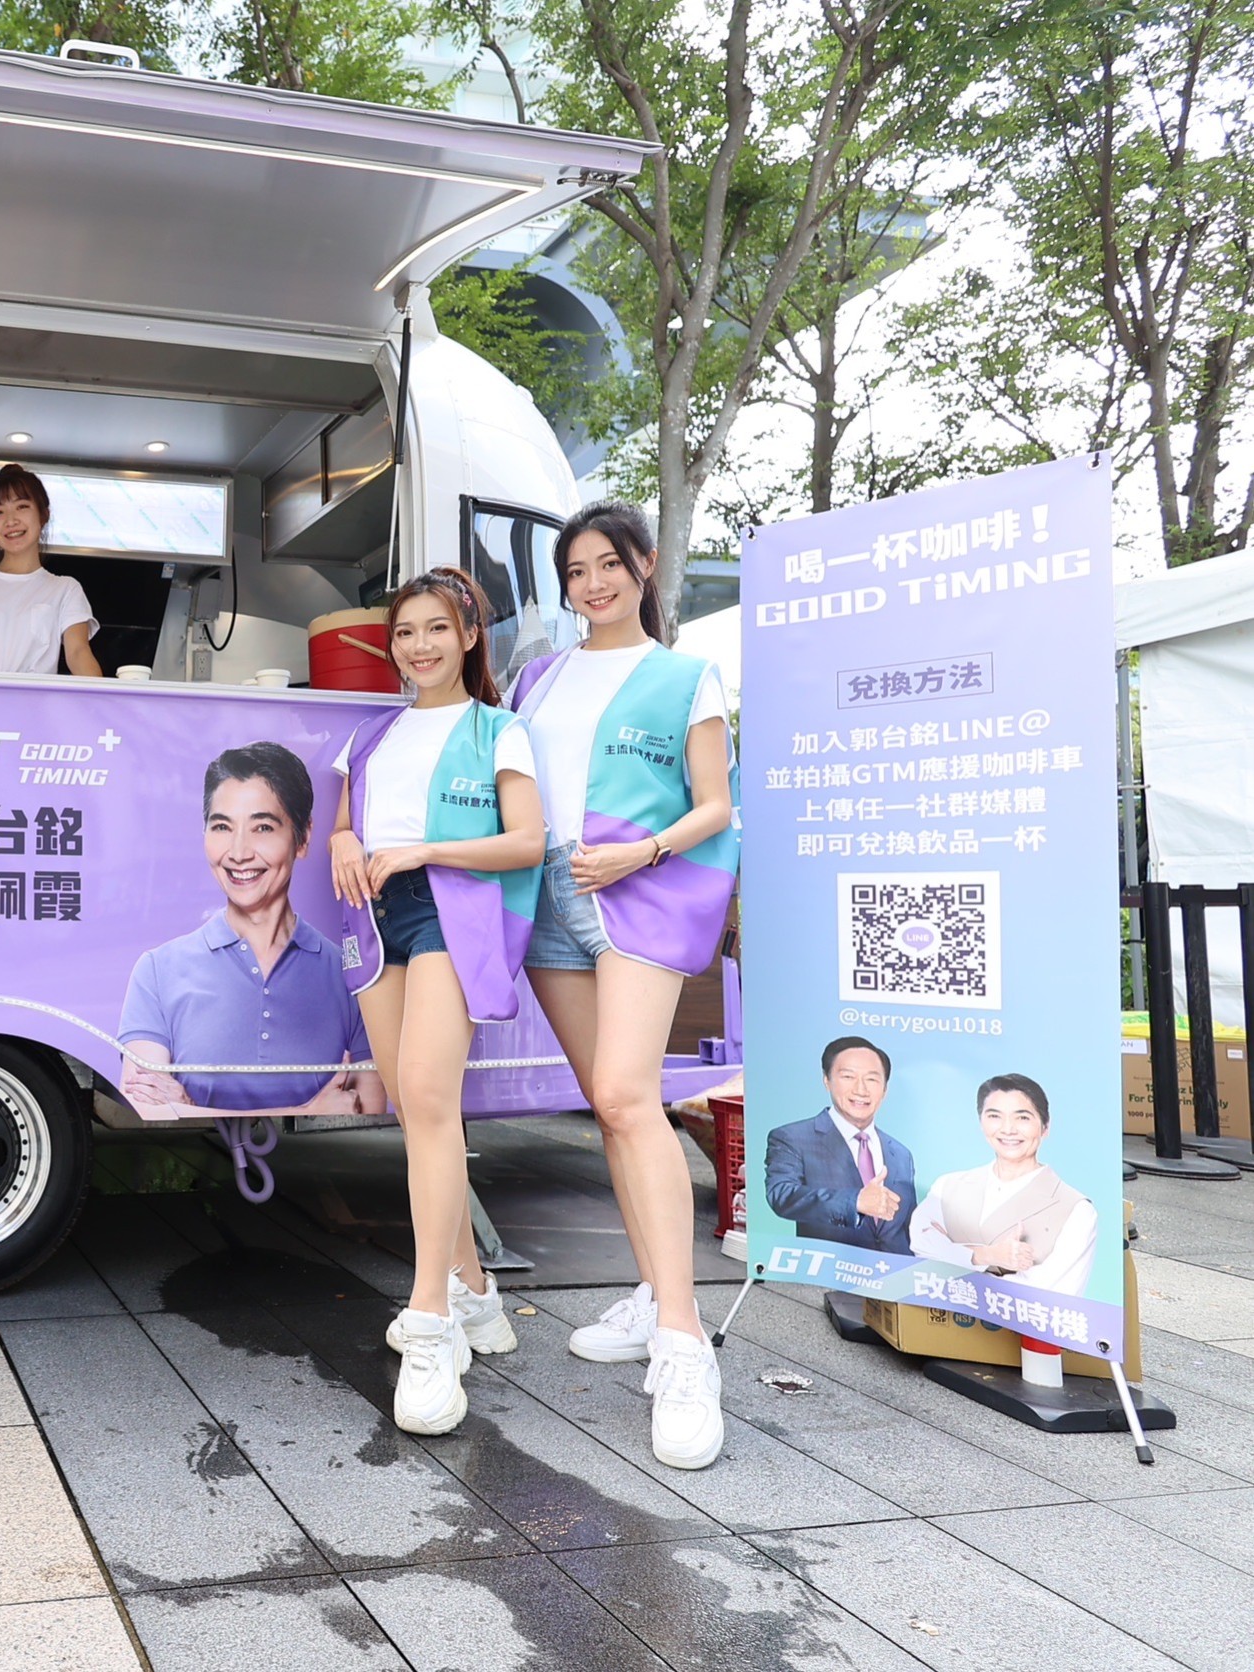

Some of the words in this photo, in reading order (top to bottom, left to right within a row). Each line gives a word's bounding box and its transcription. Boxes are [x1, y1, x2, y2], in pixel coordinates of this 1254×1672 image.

[756, 586, 887, 628] GOOD
[847, 661, 983, 702] 兌換方法
[618, 726, 649, 744] GT
[791, 709, 1051, 755] 加入郭台銘LINE@
[19, 743, 93, 762] GOOD
[765, 745, 1084, 790] 並拍攝GTM應援咖啡車
[450, 777, 483, 792] GT
[796, 786, 1047, 823] 上傳任一社群媒體
[797, 825, 1047, 857] 即可兌換飲品一杯
[906, 933, 930, 943] LINE
[839, 1008, 1003, 1036] @terrygou1018
[767, 1246, 836, 1277] GT
[834, 1260, 873, 1277] GOOD
[912, 1270, 980, 1311] 改變
[983, 1287, 1090, 1344] 好時機
